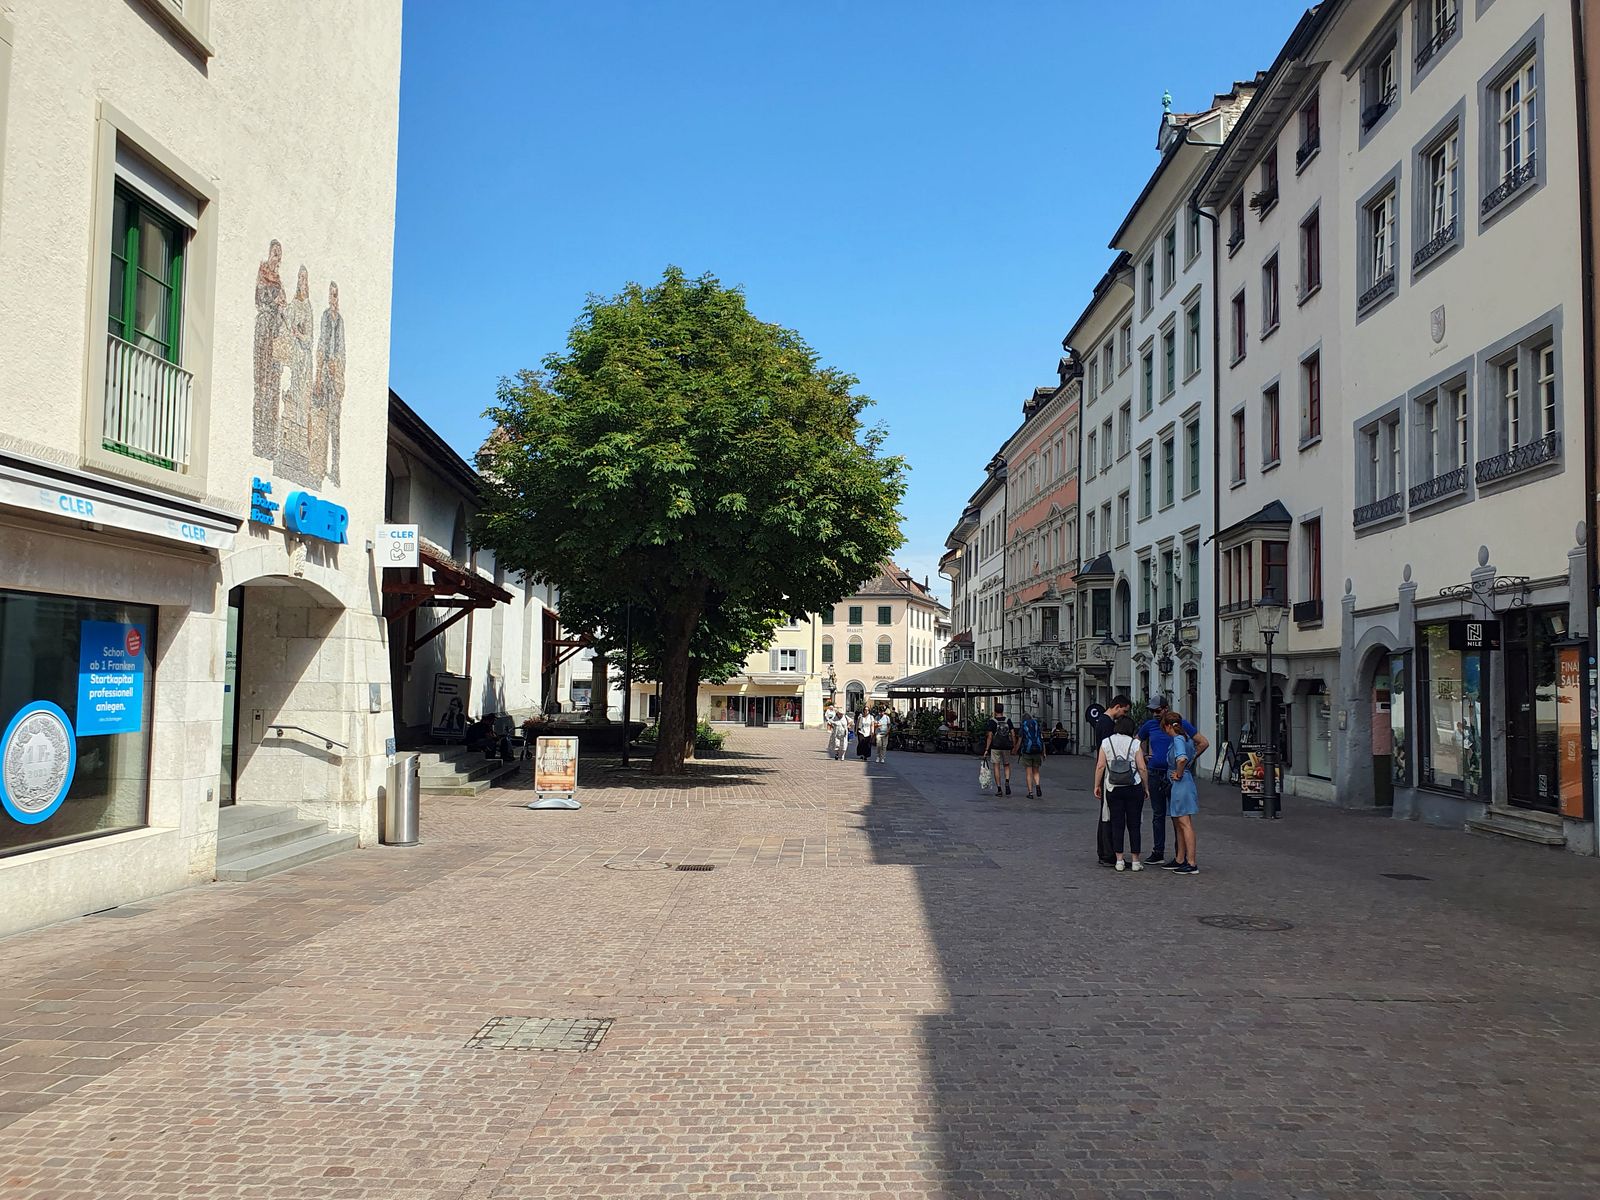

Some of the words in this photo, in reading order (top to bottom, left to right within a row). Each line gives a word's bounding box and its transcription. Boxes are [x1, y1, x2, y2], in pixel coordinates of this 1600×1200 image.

[59, 495, 94, 517] CLER
[181, 524, 207, 542] CLER
[103, 647, 125, 657] Schon
[89, 661, 100, 670] ab
[101, 661, 106, 670] 1
[107, 660, 136, 671] Franken
[90, 673, 134, 686] Startkapital
[1561, 674, 1580, 686] SALE
[89, 687, 134, 700] professionell
[96, 701, 126, 713] anlegen.
